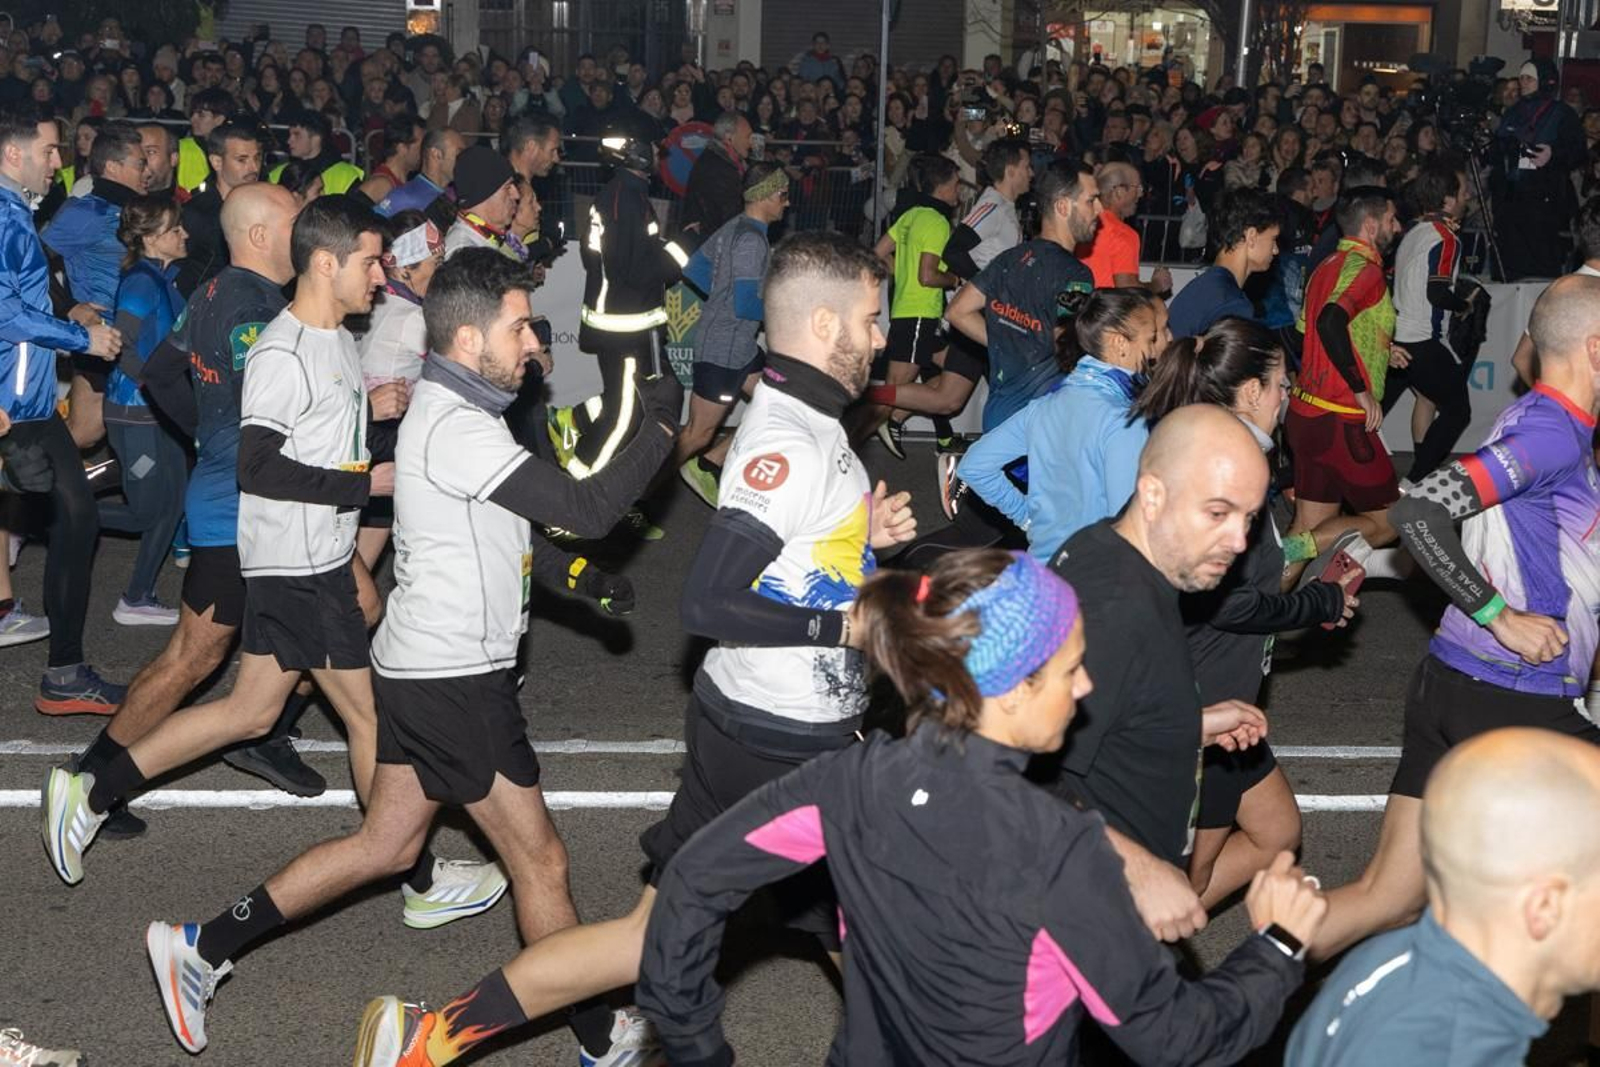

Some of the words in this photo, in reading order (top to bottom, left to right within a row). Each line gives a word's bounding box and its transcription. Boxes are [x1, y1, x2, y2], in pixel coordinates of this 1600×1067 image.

[735, 486, 771, 505] moreno
[1416, 520, 1456, 572] WEEKEND
[1458, 570, 1483, 598] TRAIL
